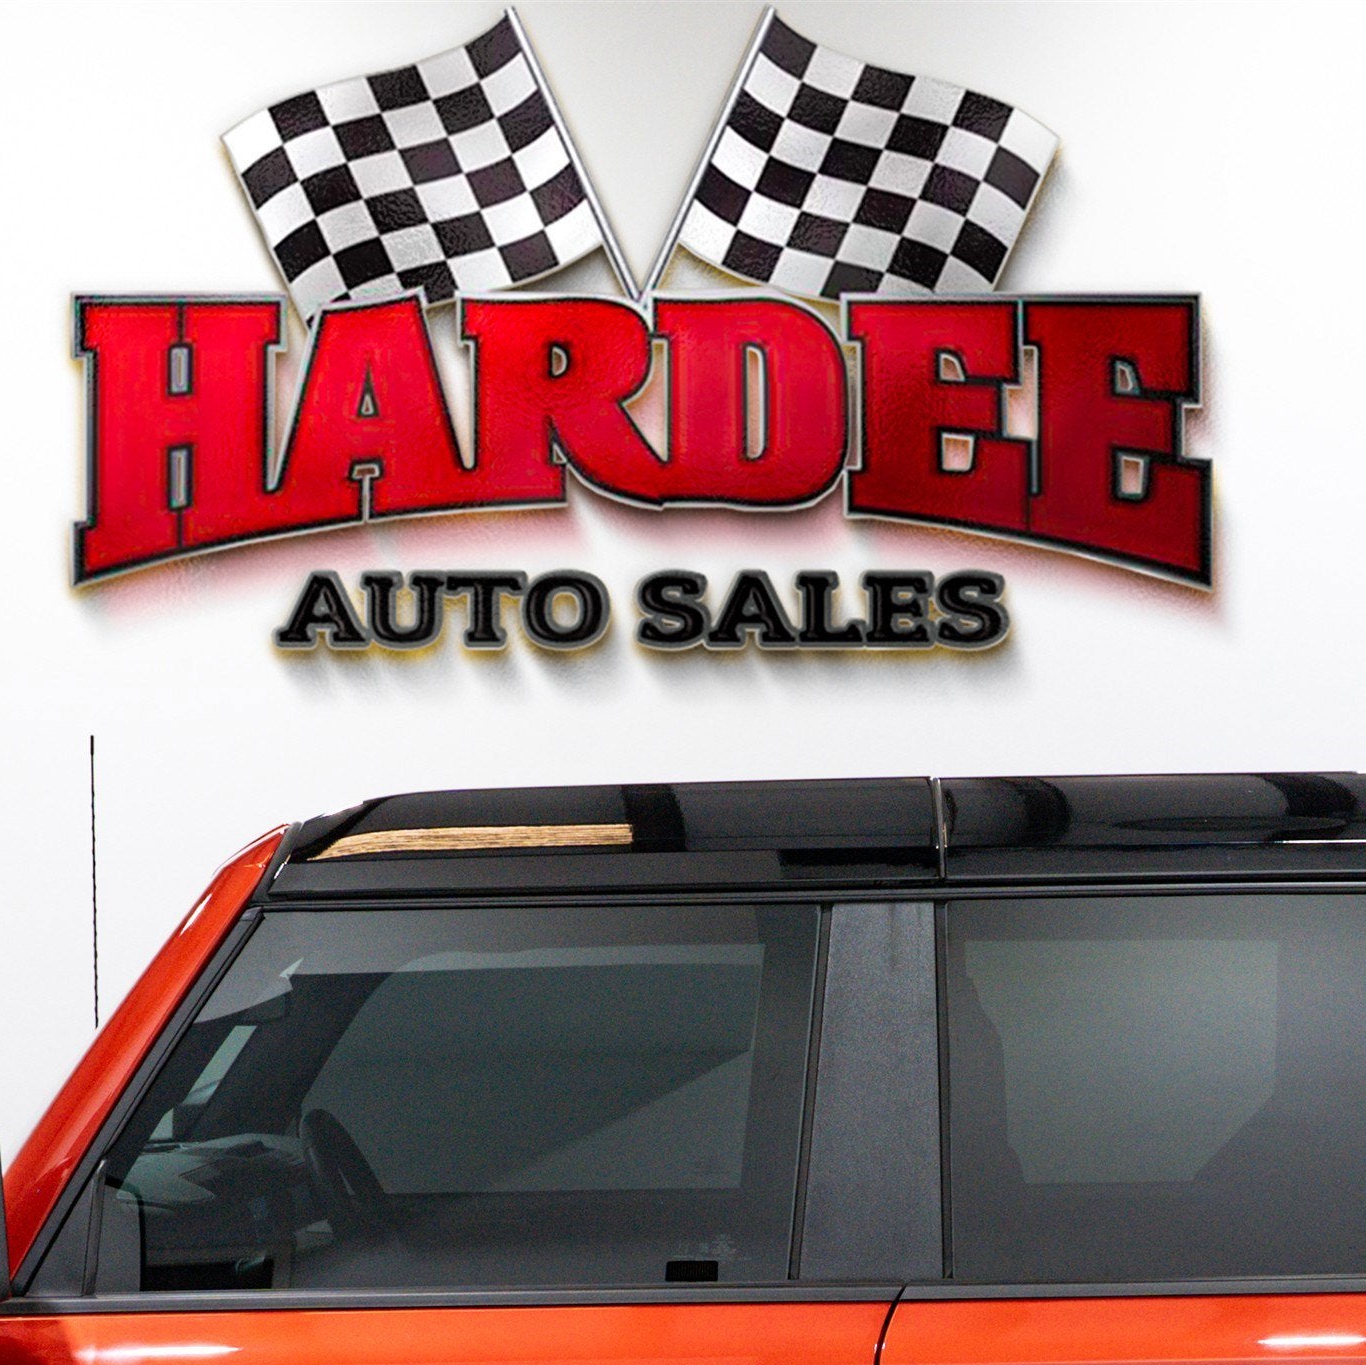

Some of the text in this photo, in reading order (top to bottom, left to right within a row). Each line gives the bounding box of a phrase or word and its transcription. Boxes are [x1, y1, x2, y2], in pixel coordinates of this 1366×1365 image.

[71, 292, 1215, 588] HARDEE
[274, 570, 1010, 649] AUTO SALES
